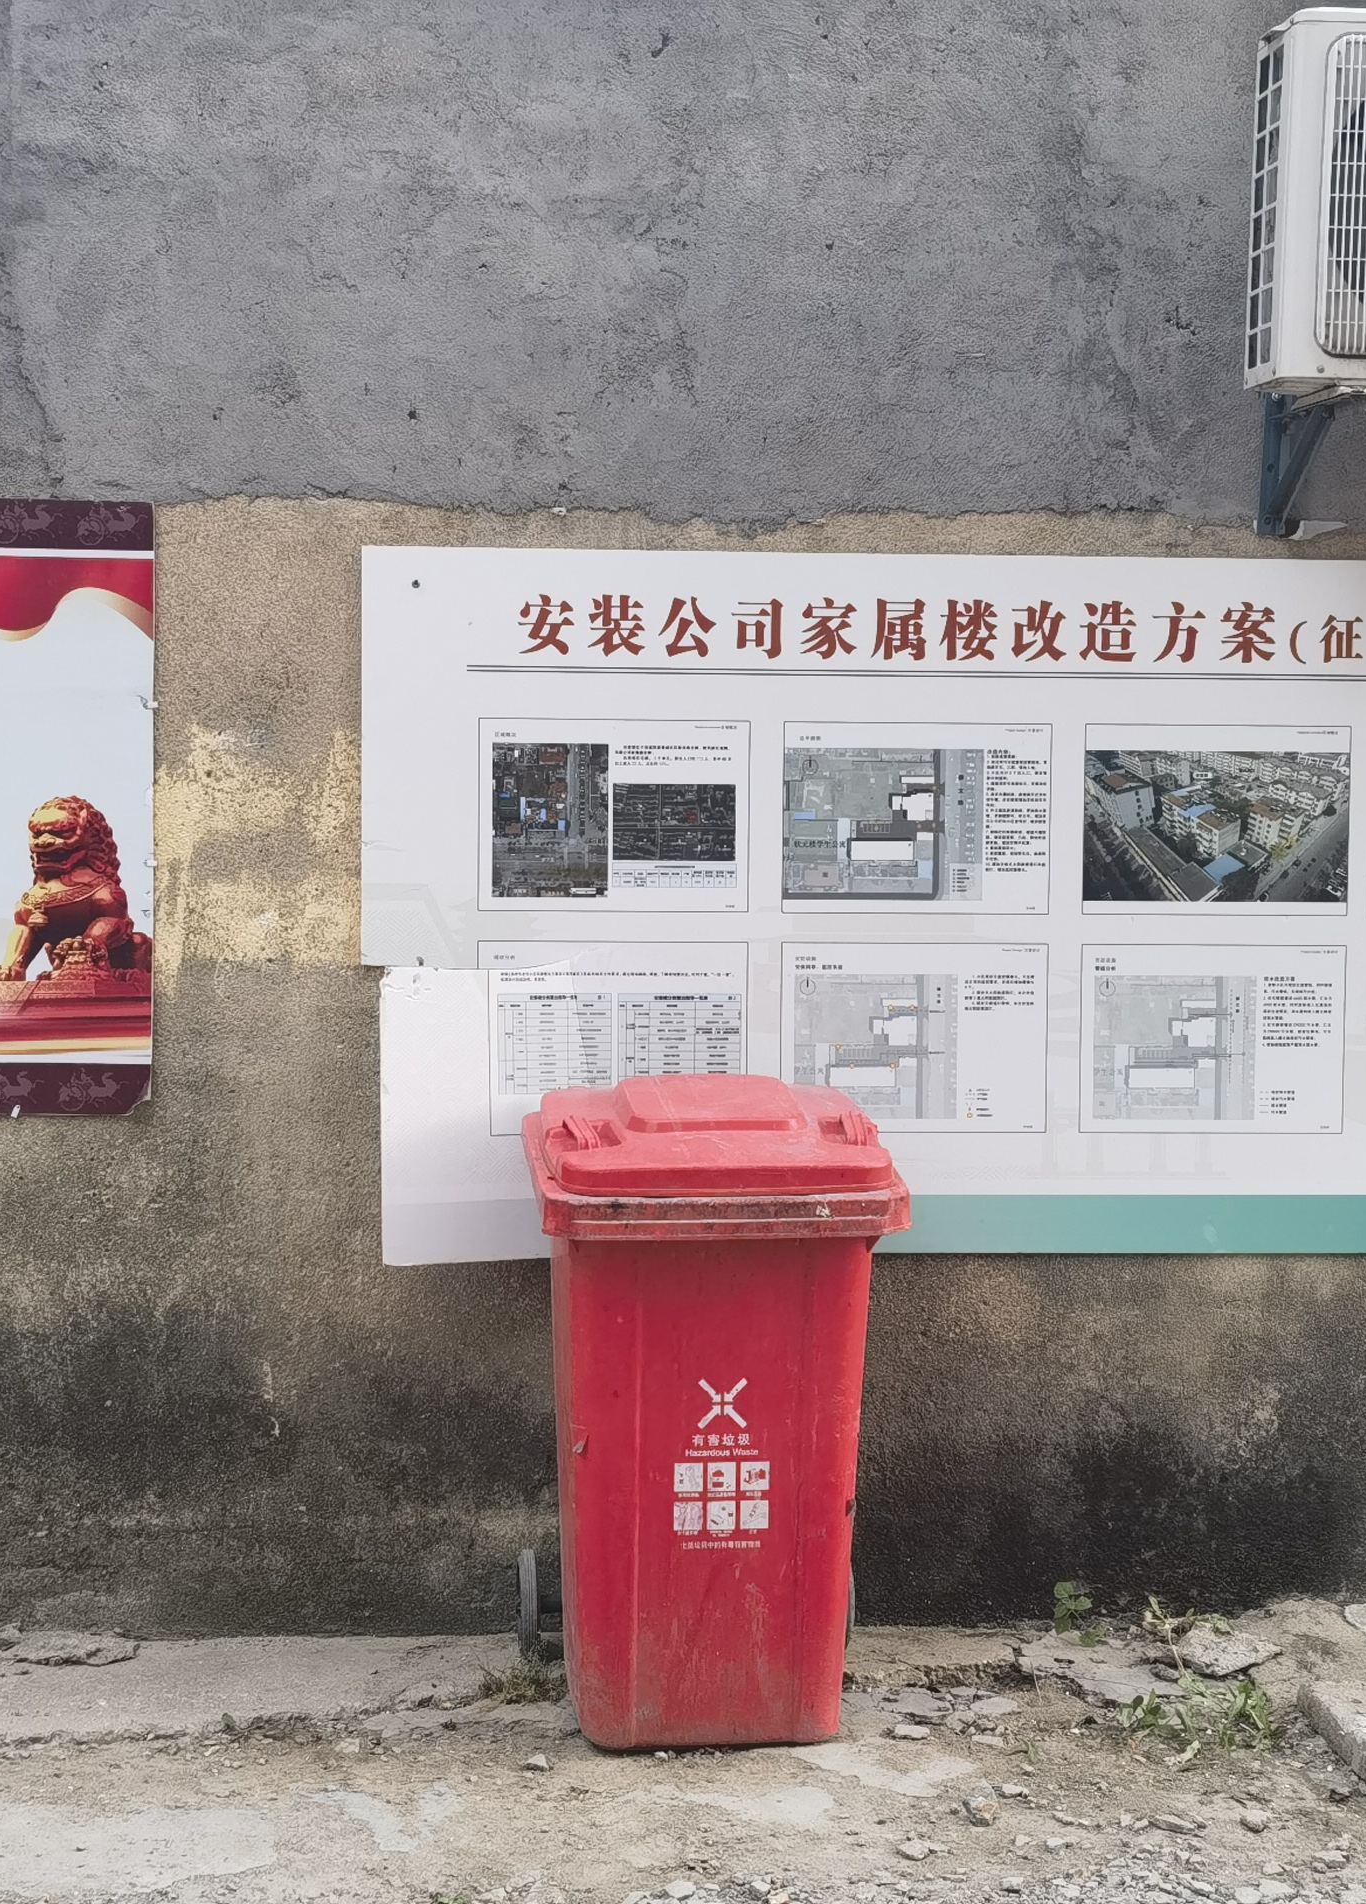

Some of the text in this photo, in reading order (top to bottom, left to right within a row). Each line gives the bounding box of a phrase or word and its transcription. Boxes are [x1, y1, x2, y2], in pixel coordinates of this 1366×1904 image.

[691, 1432, 752, 1448] 有害垃圾
[684, 1447, 759, 1457] Hazardous Waste
